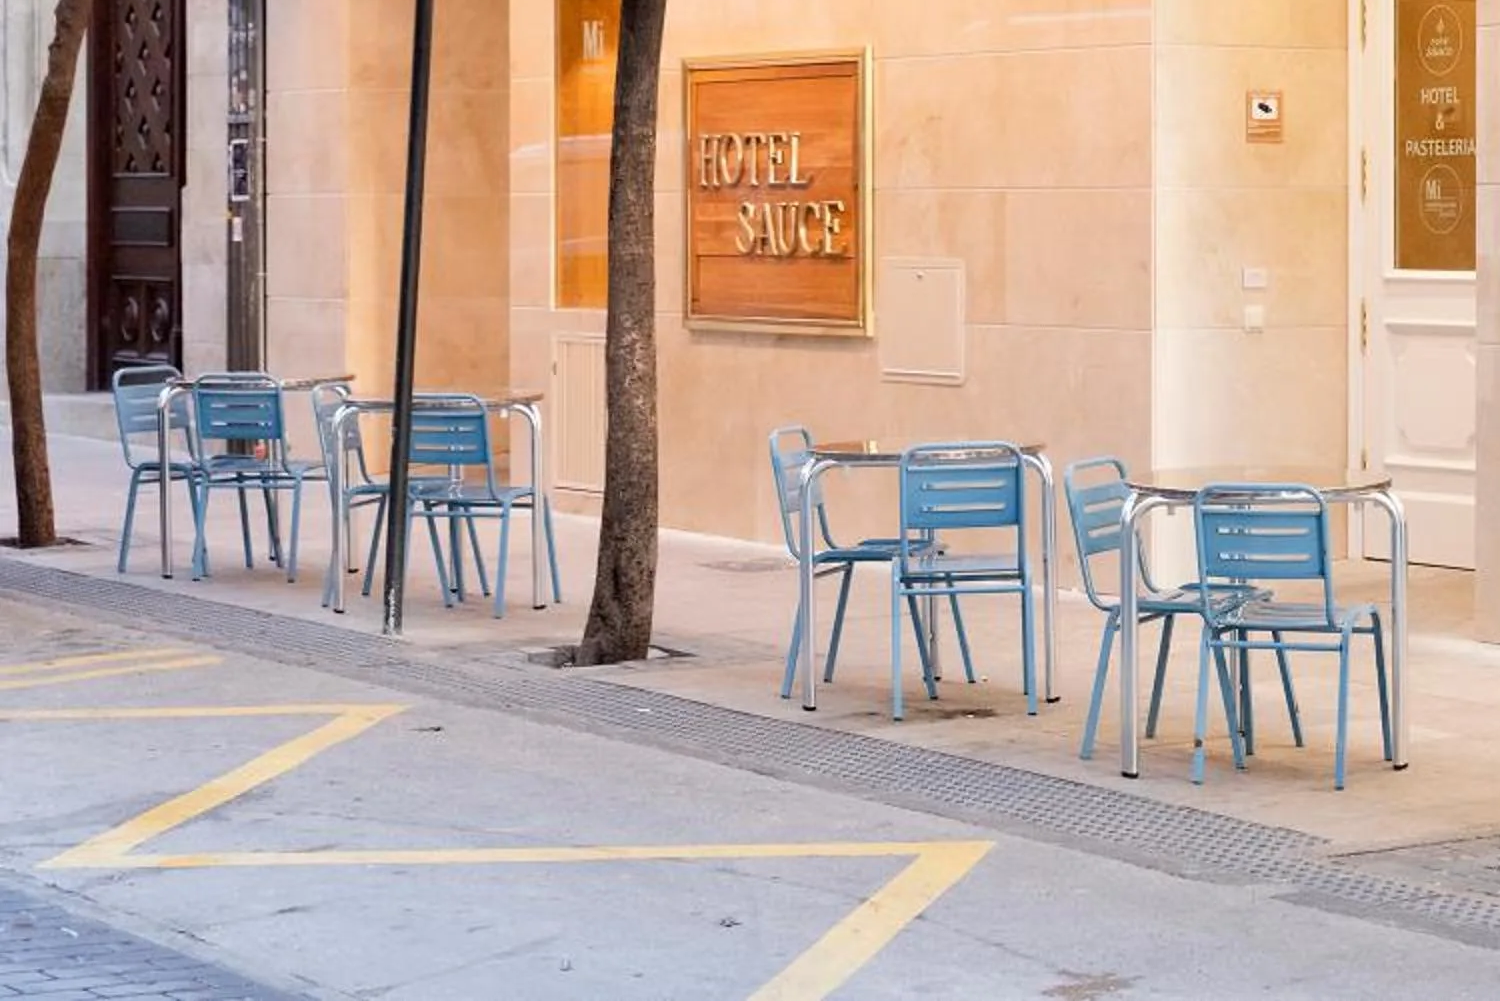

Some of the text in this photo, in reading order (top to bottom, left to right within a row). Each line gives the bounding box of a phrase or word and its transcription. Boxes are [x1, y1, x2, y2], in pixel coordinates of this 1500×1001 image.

[583, 20, 605, 60] Mi
[1420, 86, 1460, 105] HOTEL
[699, 132, 812, 188] HOTEL
[1425, 180, 1442, 200] Mi
[735, 199, 847, 257] SAUCE
